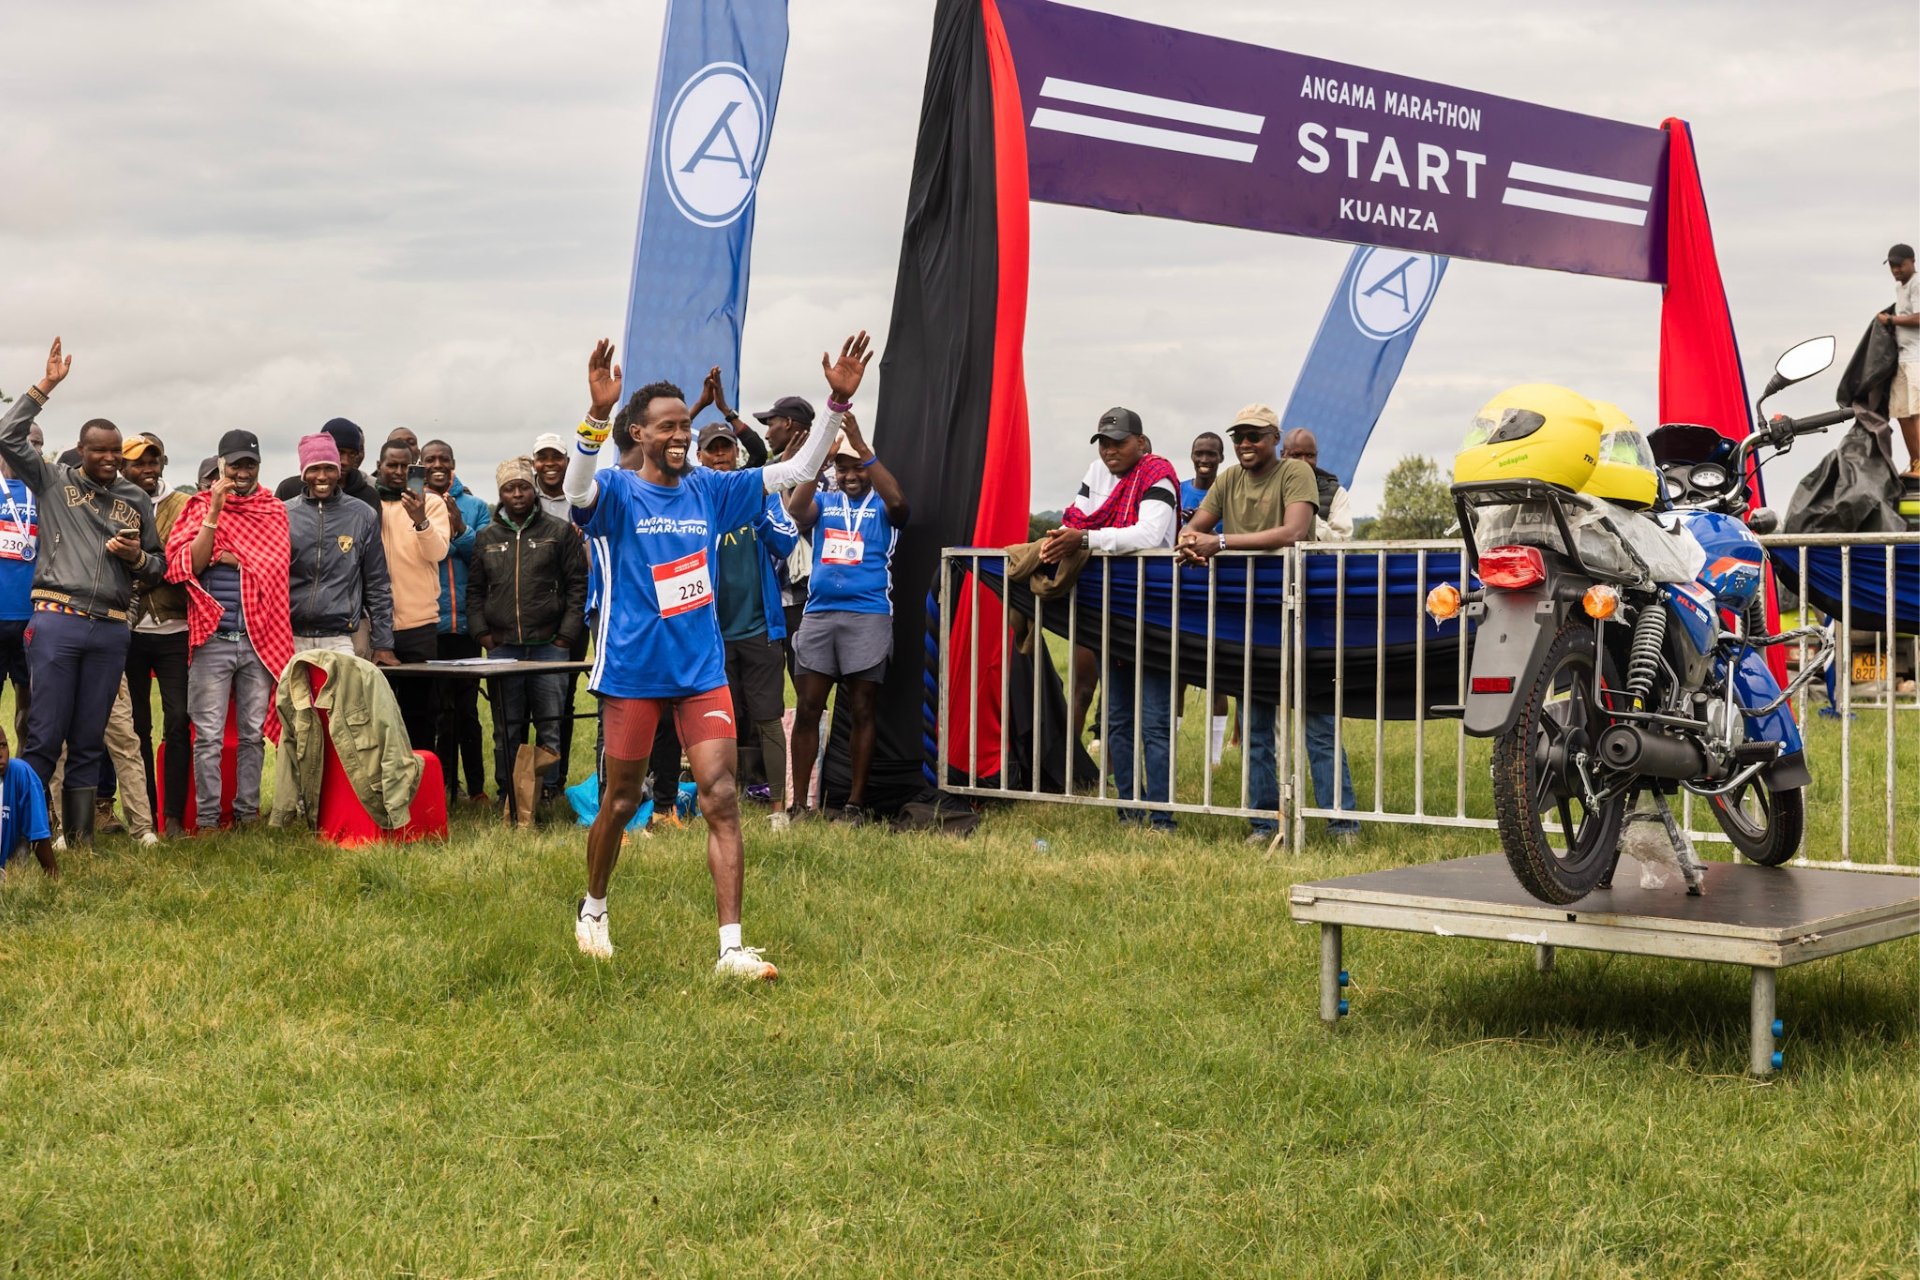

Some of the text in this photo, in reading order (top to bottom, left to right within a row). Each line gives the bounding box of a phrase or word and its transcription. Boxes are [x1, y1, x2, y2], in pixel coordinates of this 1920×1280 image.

[1300, 74, 1482, 132] ANGAMA MARA-THON
[679, 101, 750, 179] A
[1297, 121, 1488, 199] START
[1339, 197, 1440, 234] KUANZA
[1361, 256, 1421, 314] A
[2, 539, 24, 551] 230
[679, 580, 704, 600] 228
